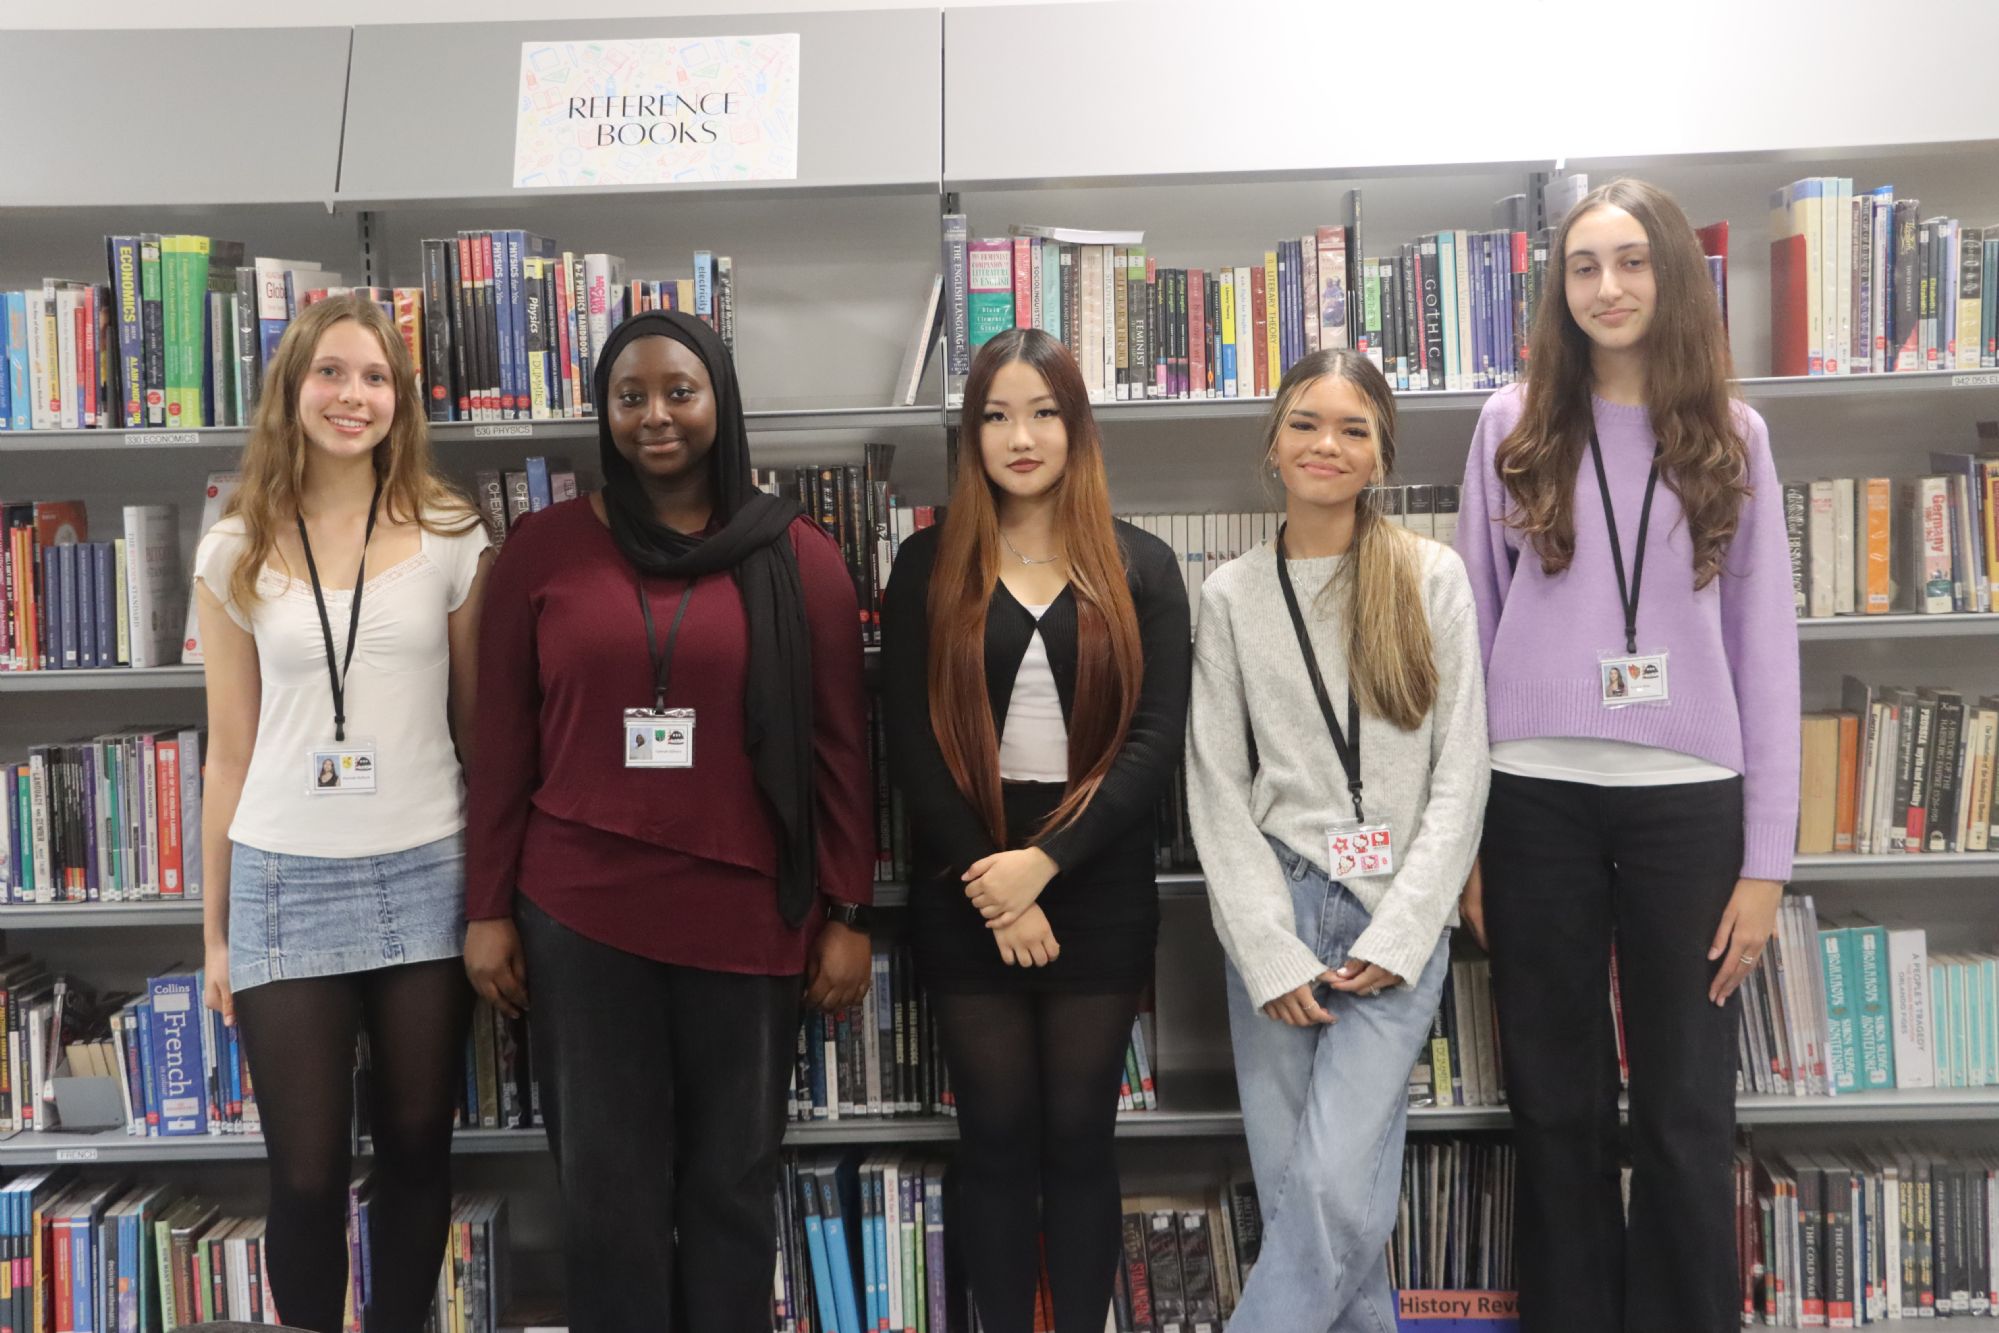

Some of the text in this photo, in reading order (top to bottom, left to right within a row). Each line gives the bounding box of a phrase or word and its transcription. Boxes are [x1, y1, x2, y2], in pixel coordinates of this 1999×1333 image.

[569, 93, 738, 118] REFERENCE
[597, 121, 718, 146] BOOKS
[493, 241, 504, 277] PHYSICS
[508, 241, 519, 277] PHYSICS
[119, 247, 136, 322] ECONOMICS
[496, 292, 504, 305] You
[511, 292, 519, 305] You
[577, 280, 586, 311] PHYSICS
[697, 266, 709, 311] electricity
[953, 244, 964, 348] THE ENGLISH LANGUAGE
[1033, 266, 1042, 327] SOCIOLINGUISTICS
[528, 297, 540, 333] Physics
[1265, 270, 1279, 345] LITERARY THEORY
[1426, 279, 1443, 348] GOTHIC
[579, 314, 588, 358] HANDBOOK
[1135, 320, 1146, 367] FEMINIST
[130, 357, 139, 381] ALAIN
[127, 433, 197, 445] 330 ECONOMICS
[493, 425, 530, 434] PHYSICS
[1930, 494, 1948, 553] Germany
[1911, 708, 1930, 807] PRUSSIA myth and reality
[155, 984, 191, 994] Collins
[1898, 971, 1908, 1034] ORLANDO FIGES
[1915, 1008, 1925, 1052] TRAGEDY
[163, 1011, 193, 1097] French
[1804, 1225, 1817, 1299] THE COLD WAR
[1834, 1226, 1845, 1300] THE COLD WAR
[109, 1287, 118, 1328] mathematics
[1130, 1262, 1151, 1323] STALINGRAD
[1400, 1296, 1471, 1317] History
